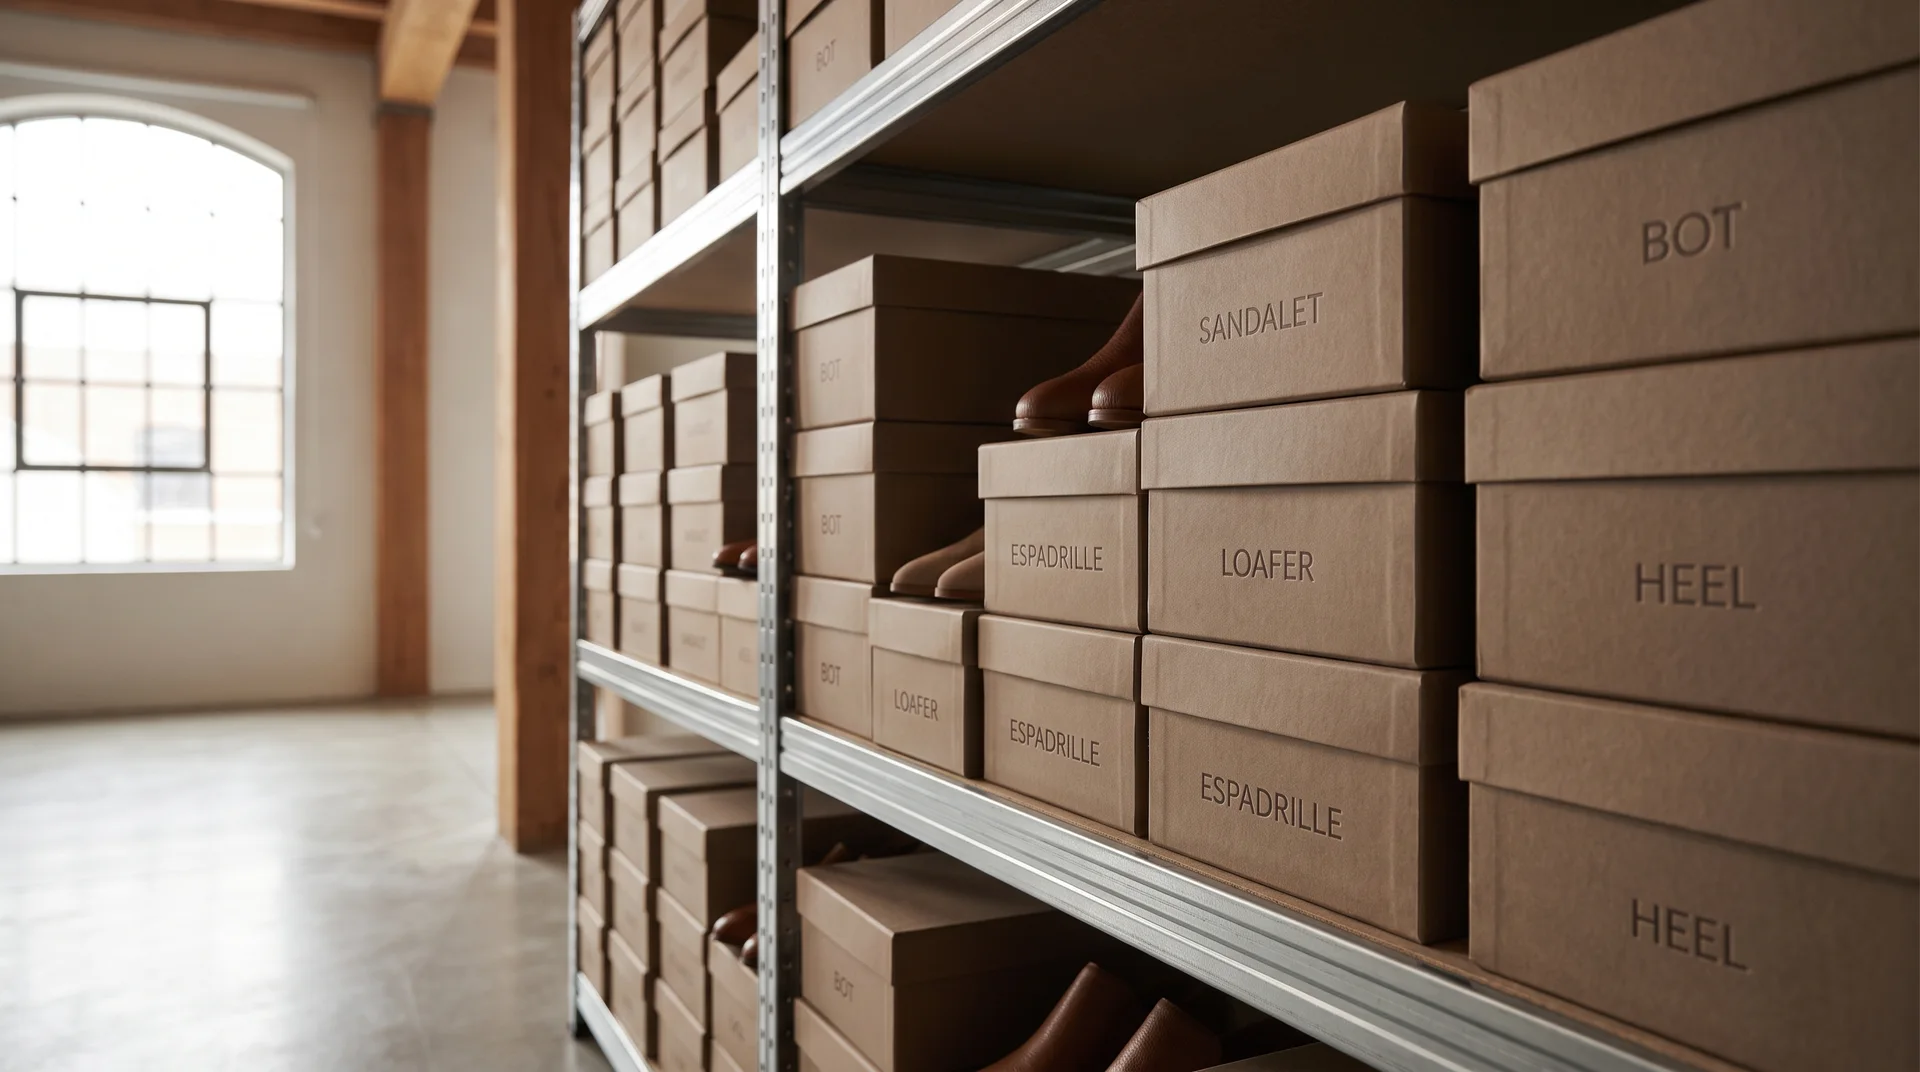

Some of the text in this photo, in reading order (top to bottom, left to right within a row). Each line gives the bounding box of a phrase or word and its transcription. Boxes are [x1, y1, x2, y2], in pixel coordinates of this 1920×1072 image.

[816, 39, 837, 72] BOT
[1641, 202, 1742, 265] BOT
[1199, 291, 1323, 345] SANDALET
[820, 358, 841, 383] BOT
[821, 514, 841, 536] BOT
[1011, 543, 1103, 572] ESPADRILLE
[1222, 548, 1315, 583] LOAFER
[1635, 563, 1758, 611] HEEL
[820, 662, 841, 687] BOT
[893, 689, 938, 721] LOAFER
[1010, 718, 1100, 768] ESPADRILLE
[1201, 772, 1343, 841] ESPADRILLE
[1632, 898, 1749, 972] HEEL
[834, 970, 855, 1001] BOT
